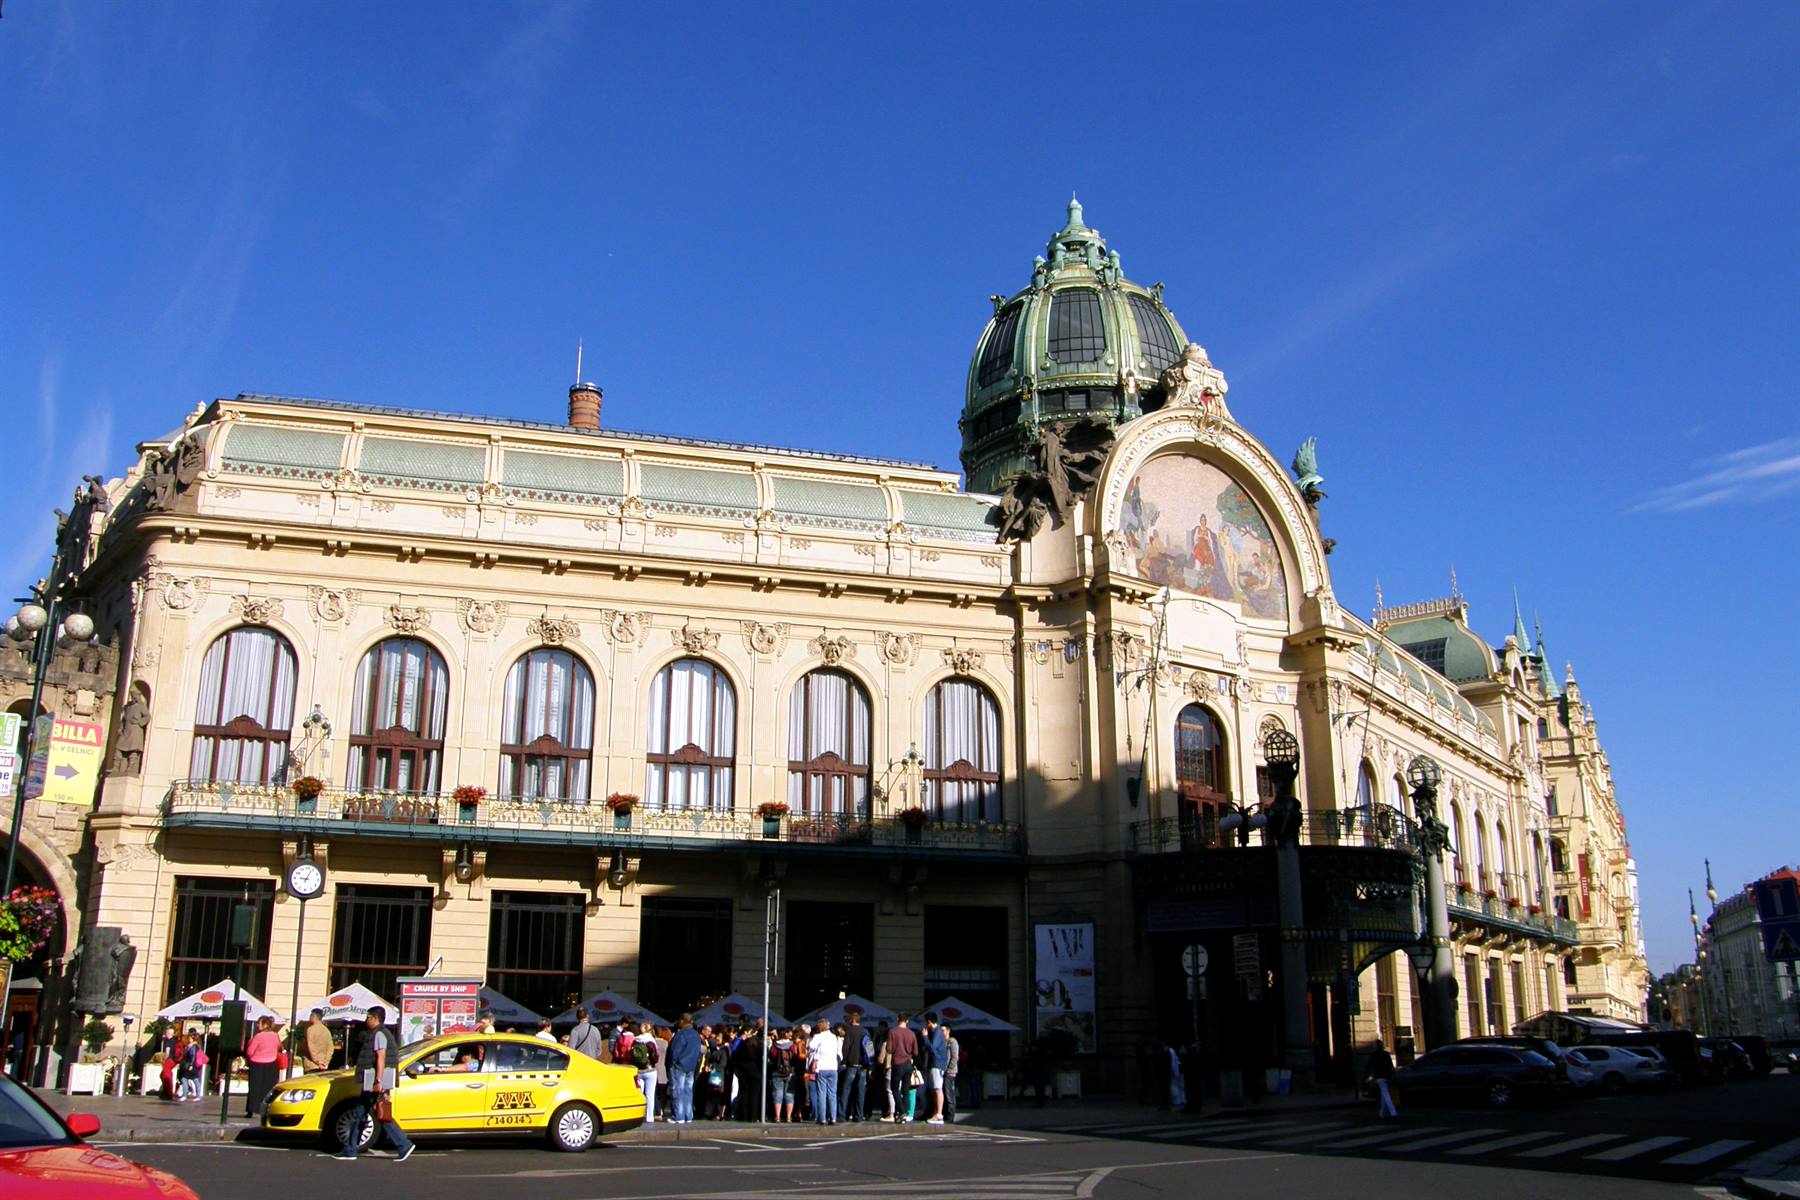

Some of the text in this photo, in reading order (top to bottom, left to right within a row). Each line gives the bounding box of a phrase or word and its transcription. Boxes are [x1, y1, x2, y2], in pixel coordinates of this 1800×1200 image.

[53, 722, 98, 744] BILLA
[413, 985, 467, 993] CRUISE BY SHIP
[491, 1091, 537, 1110] AAA
[495, 1115, 525, 1125] 14014
